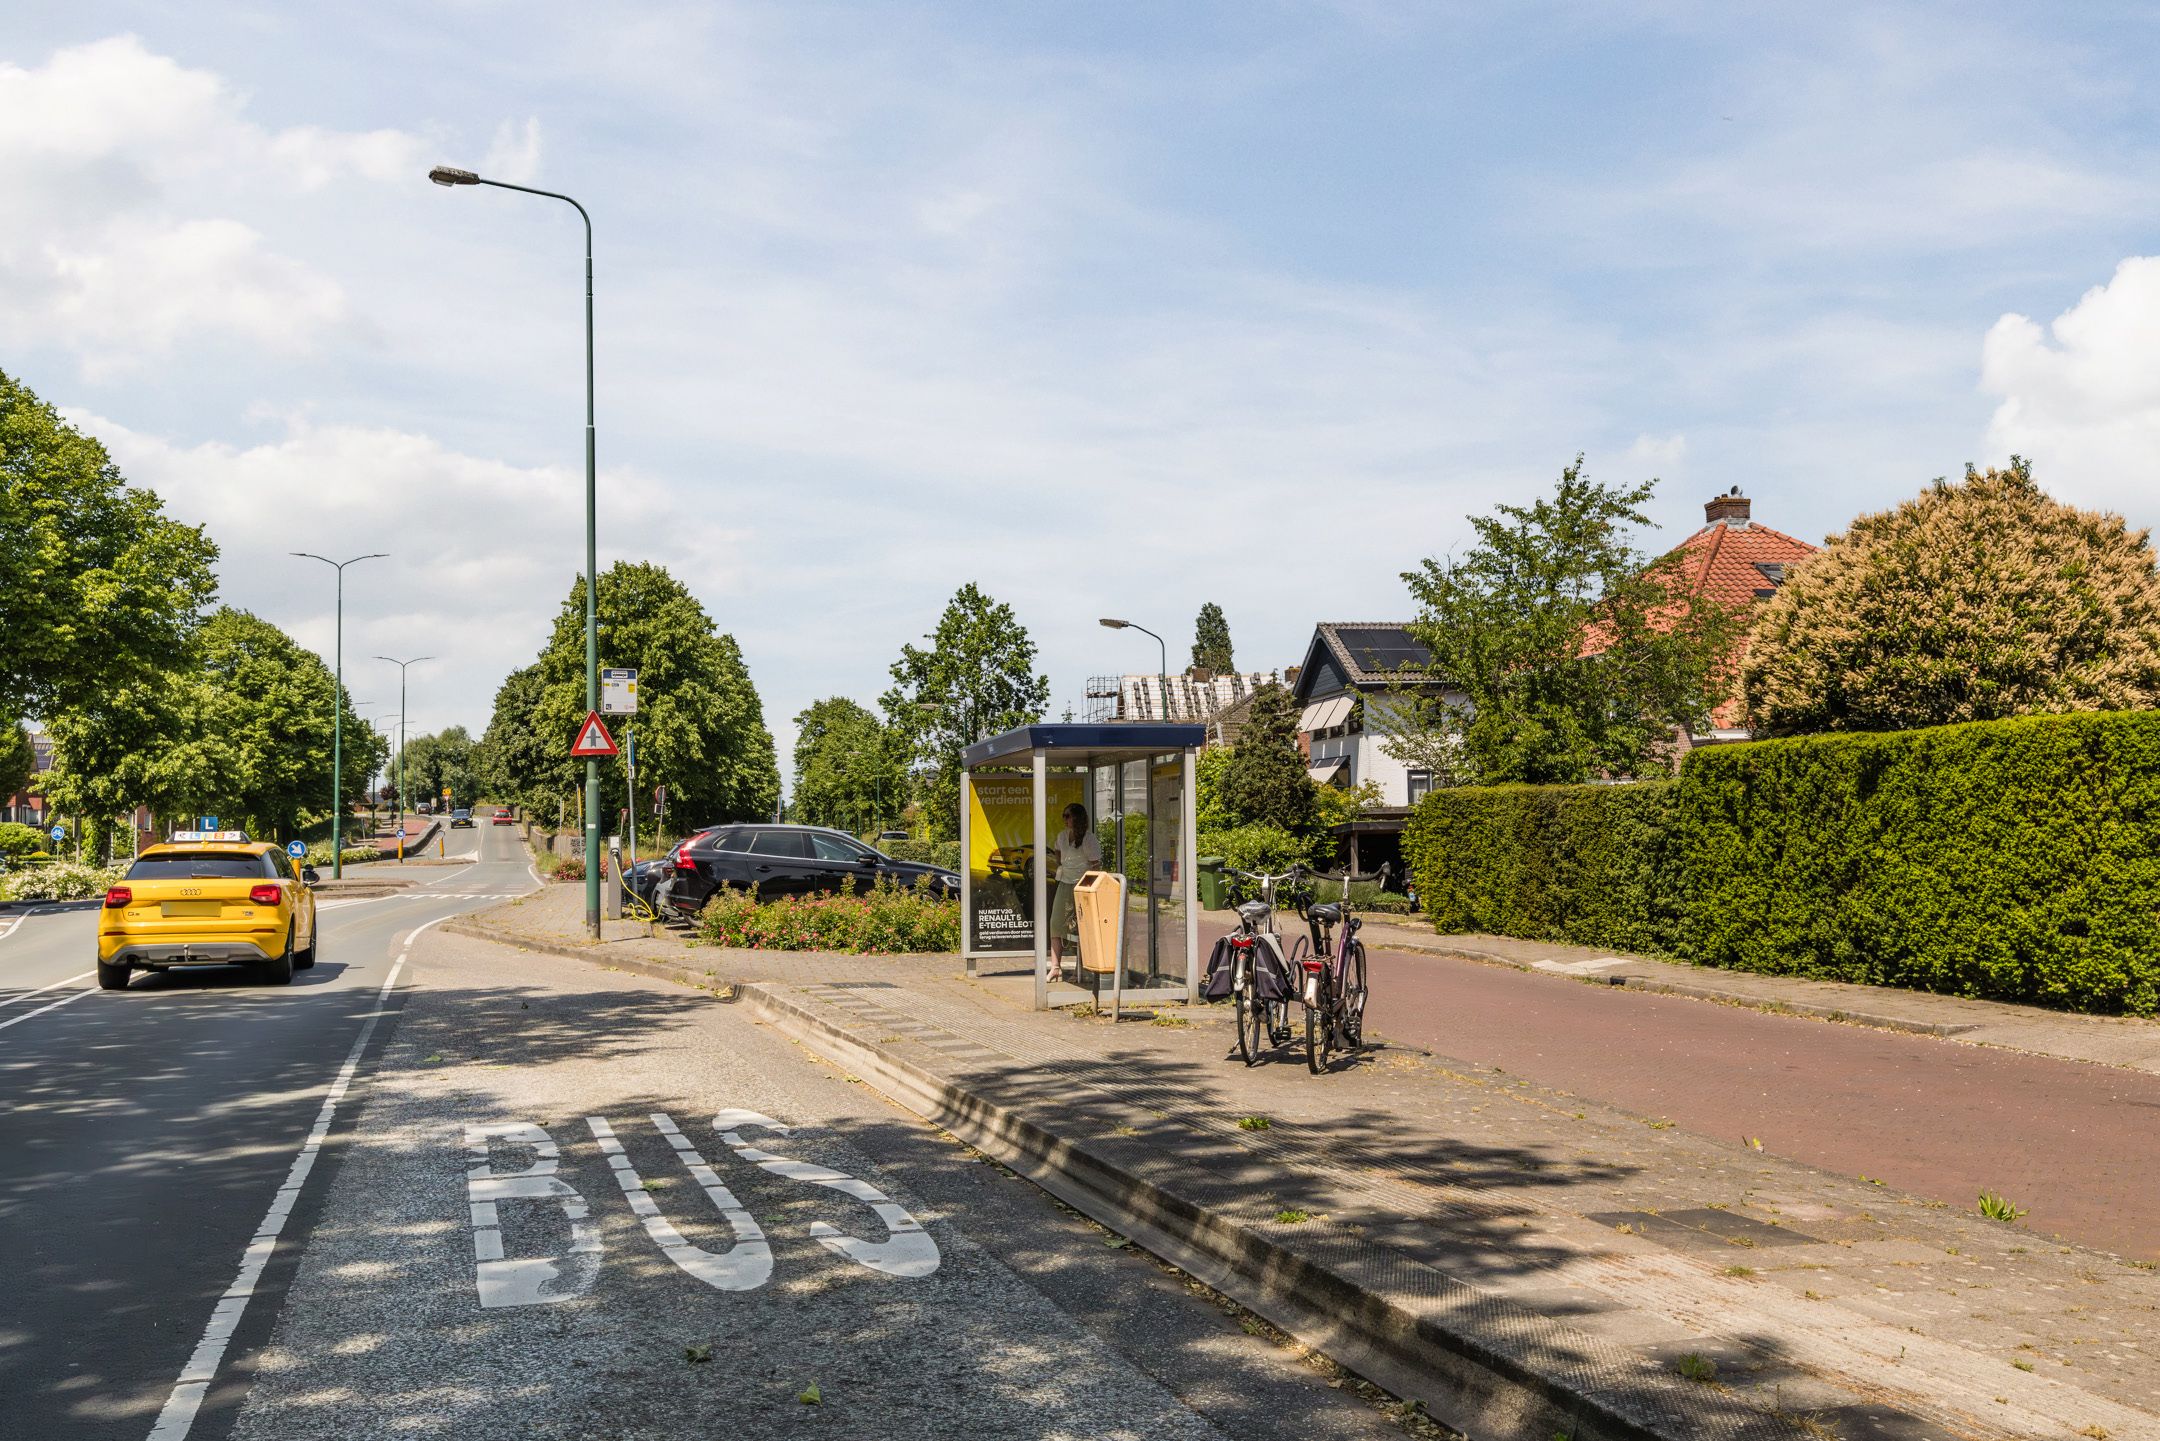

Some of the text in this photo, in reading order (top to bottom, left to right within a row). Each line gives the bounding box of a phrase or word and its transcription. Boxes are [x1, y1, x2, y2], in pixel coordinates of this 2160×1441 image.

[977, 785, 1029, 795] start een
[977, 795, 1057, 805] verdienmel
[205, 818, 214, 830] L
[464, 1108, 941, 1308] BUS
